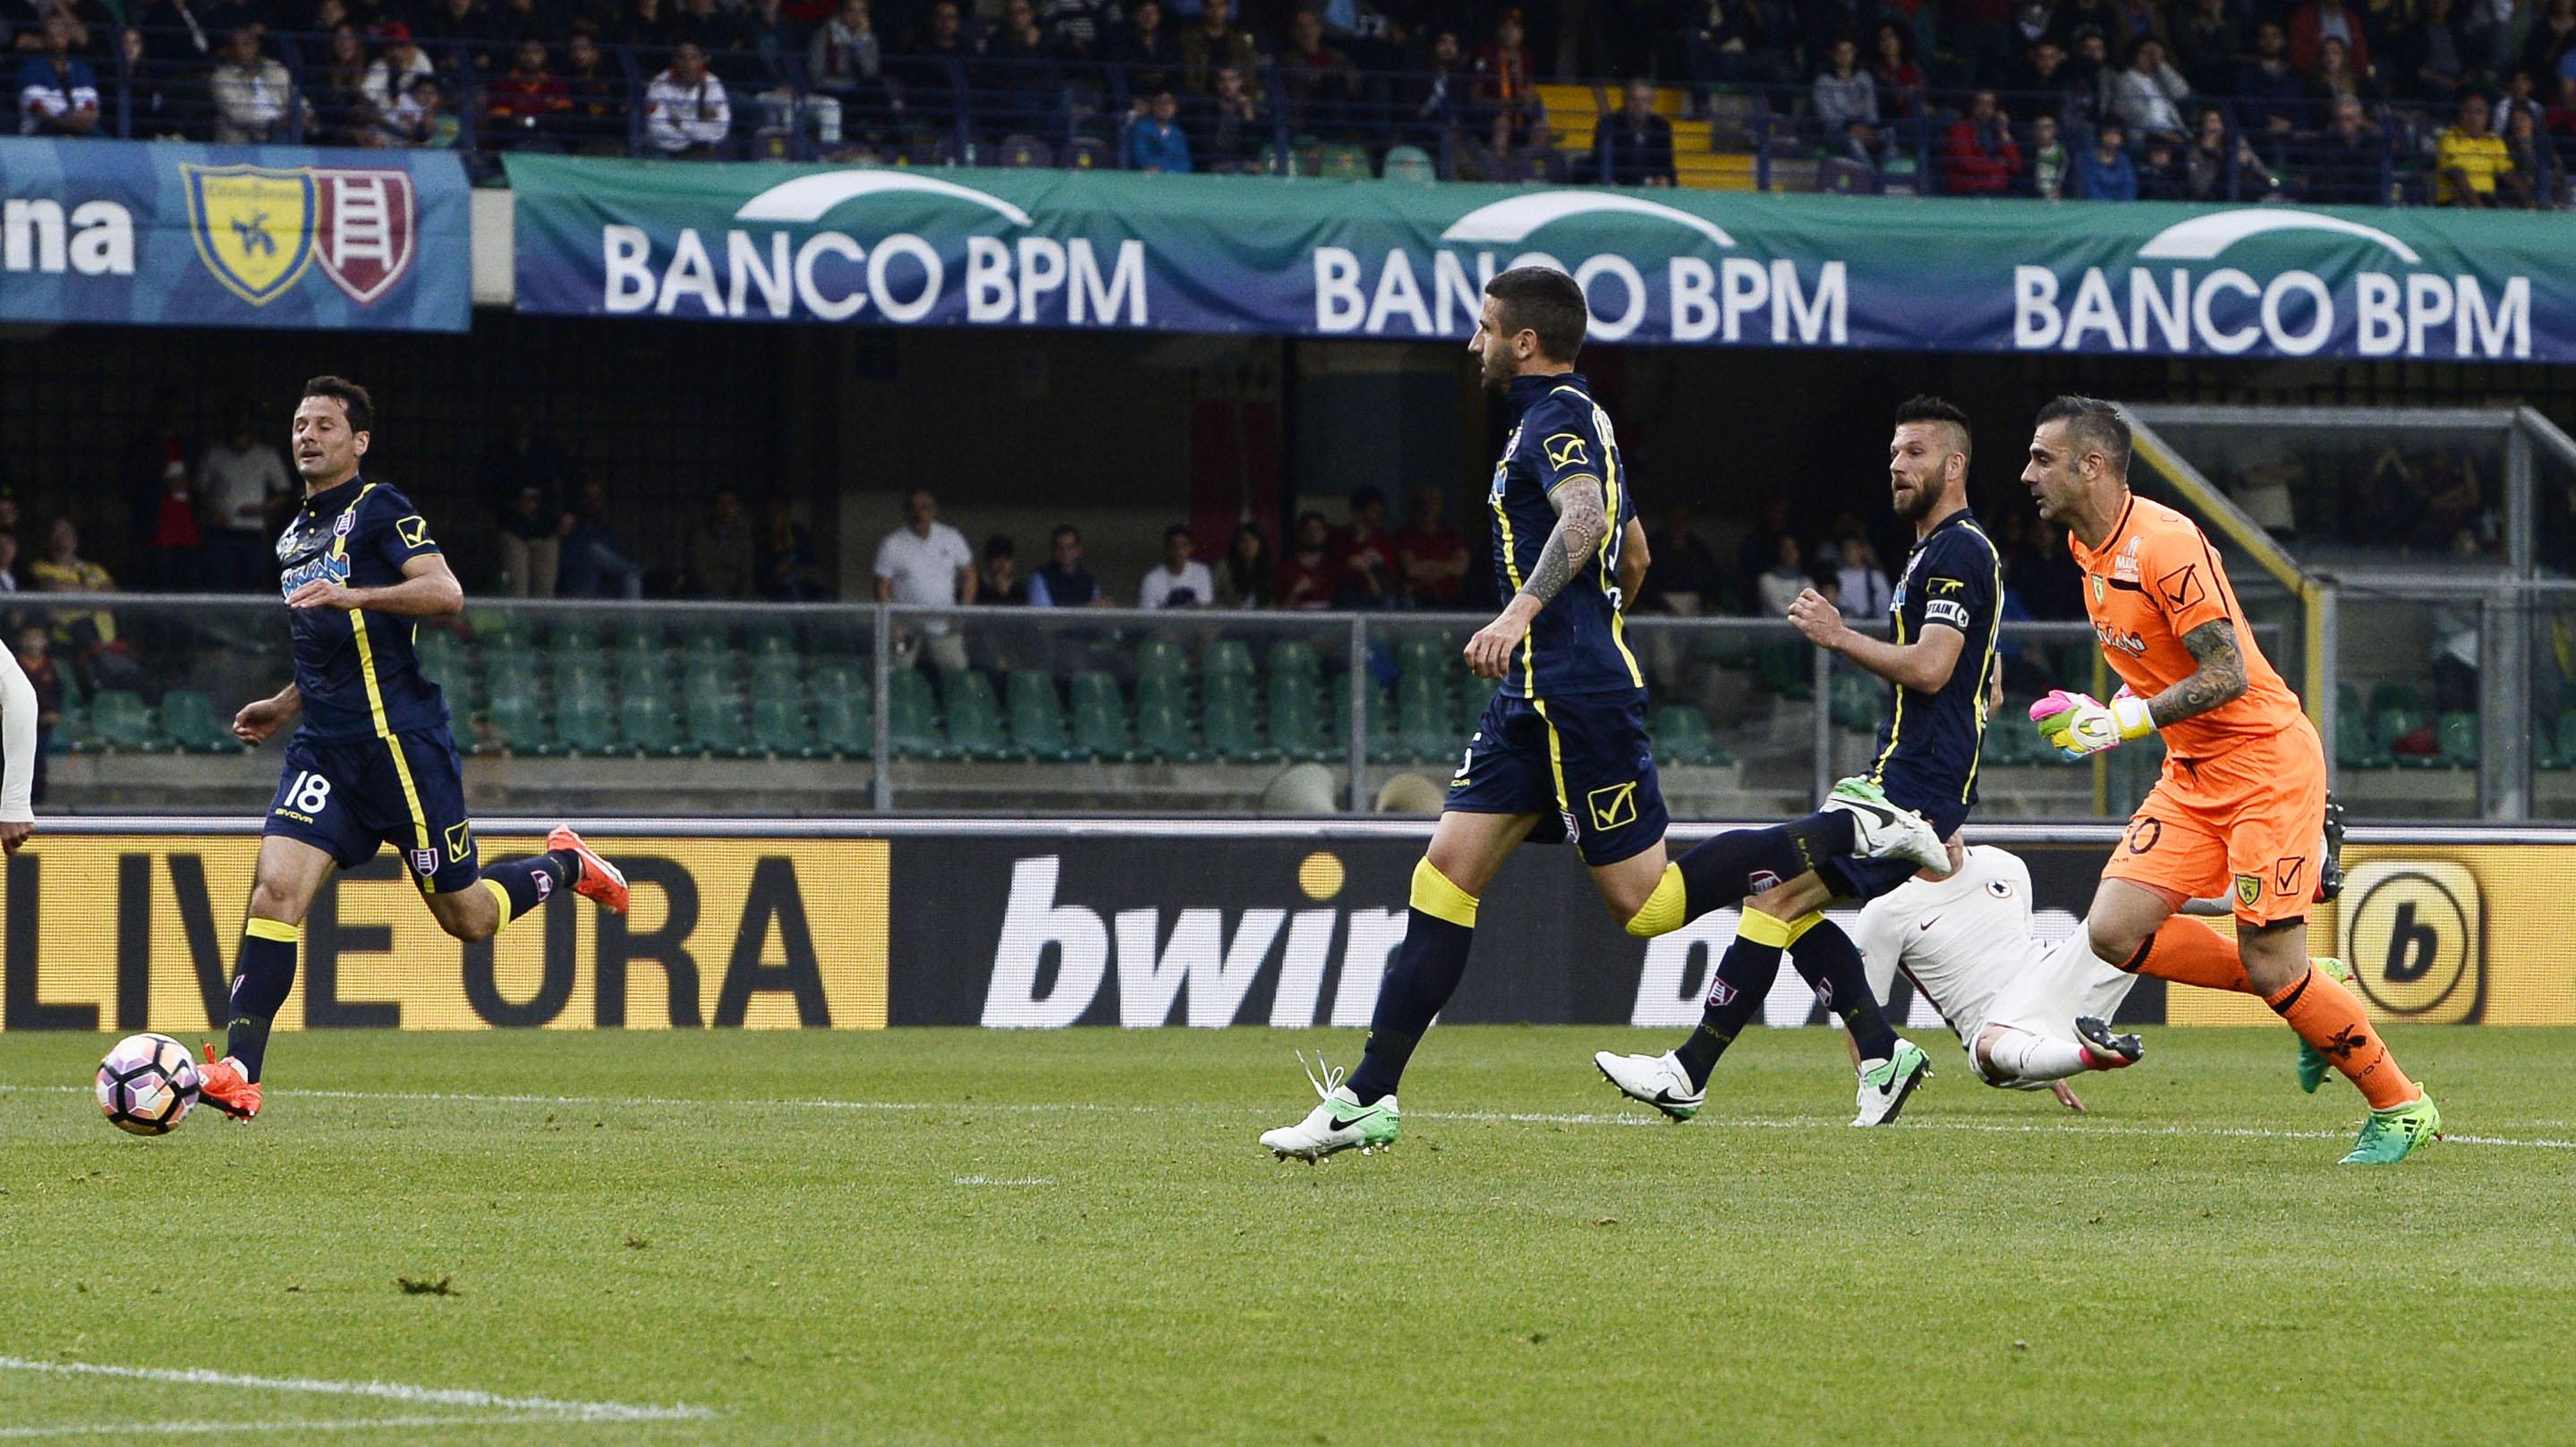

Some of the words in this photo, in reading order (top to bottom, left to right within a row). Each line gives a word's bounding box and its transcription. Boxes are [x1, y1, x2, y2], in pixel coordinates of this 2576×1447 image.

[0, 199, 135, 275] na
[603, 224, 944, 322] BANCO
[966, 236, 1149, 327] BPM
[1314, 245, 1646, 341] BANO
[1670, 257, 1849, 345] BPM
[2014, 265, 2334, 355] BANCO
[2356, 271, 2532, 359] BPM
[284, 770, 331, 813] 18
[4, 853, 402, 1030] LIVE
[462, 853, 832, 1028] ORA
